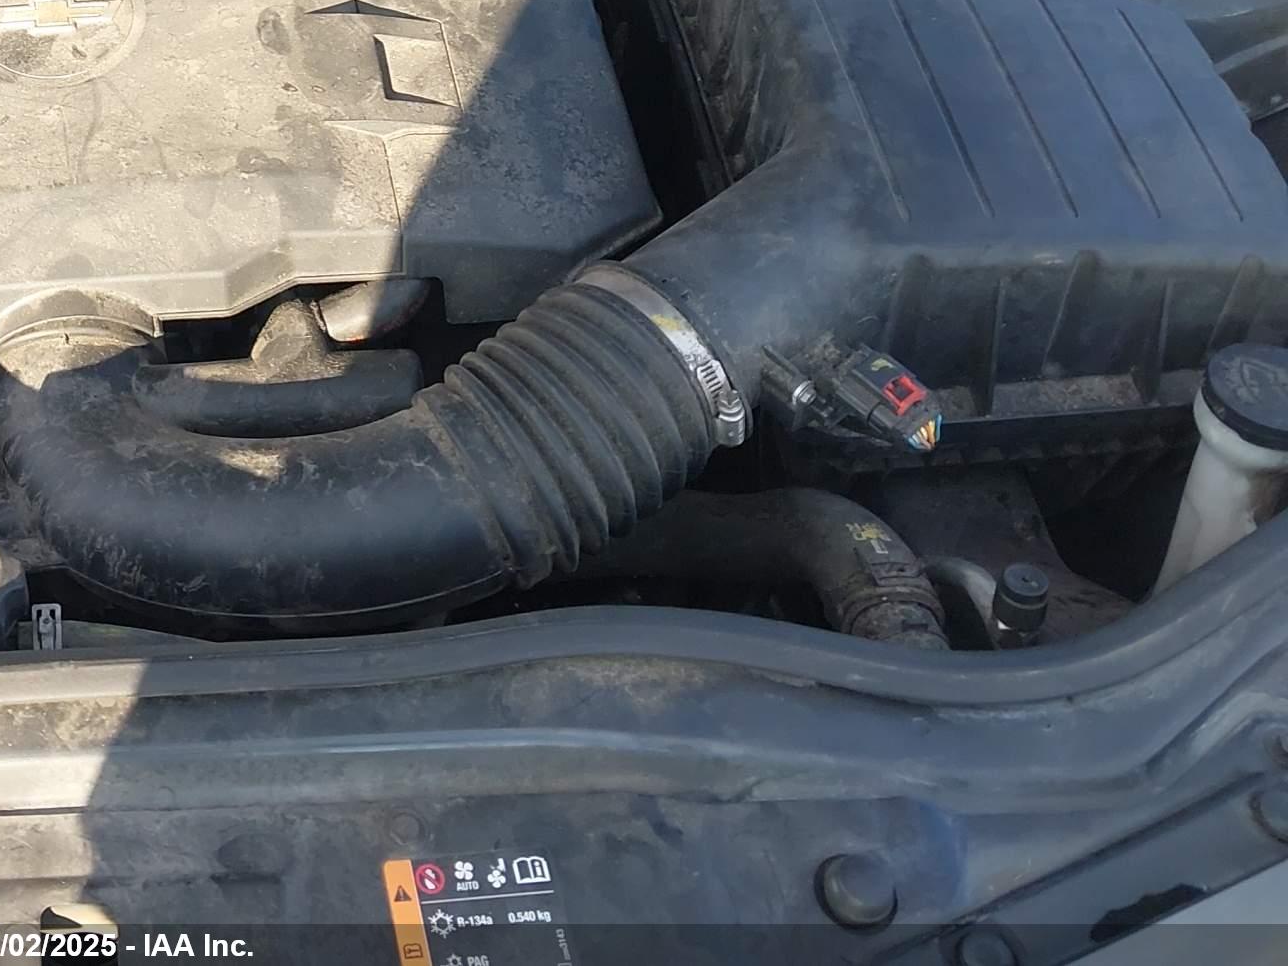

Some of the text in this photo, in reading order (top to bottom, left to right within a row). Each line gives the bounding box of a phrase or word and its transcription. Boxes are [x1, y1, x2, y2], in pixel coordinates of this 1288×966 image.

[456, 881, 479, 891] AUTO
[457, 910, 551, 927] R-134a 0.540 kg
[467, 955, 490, 966] PAG
